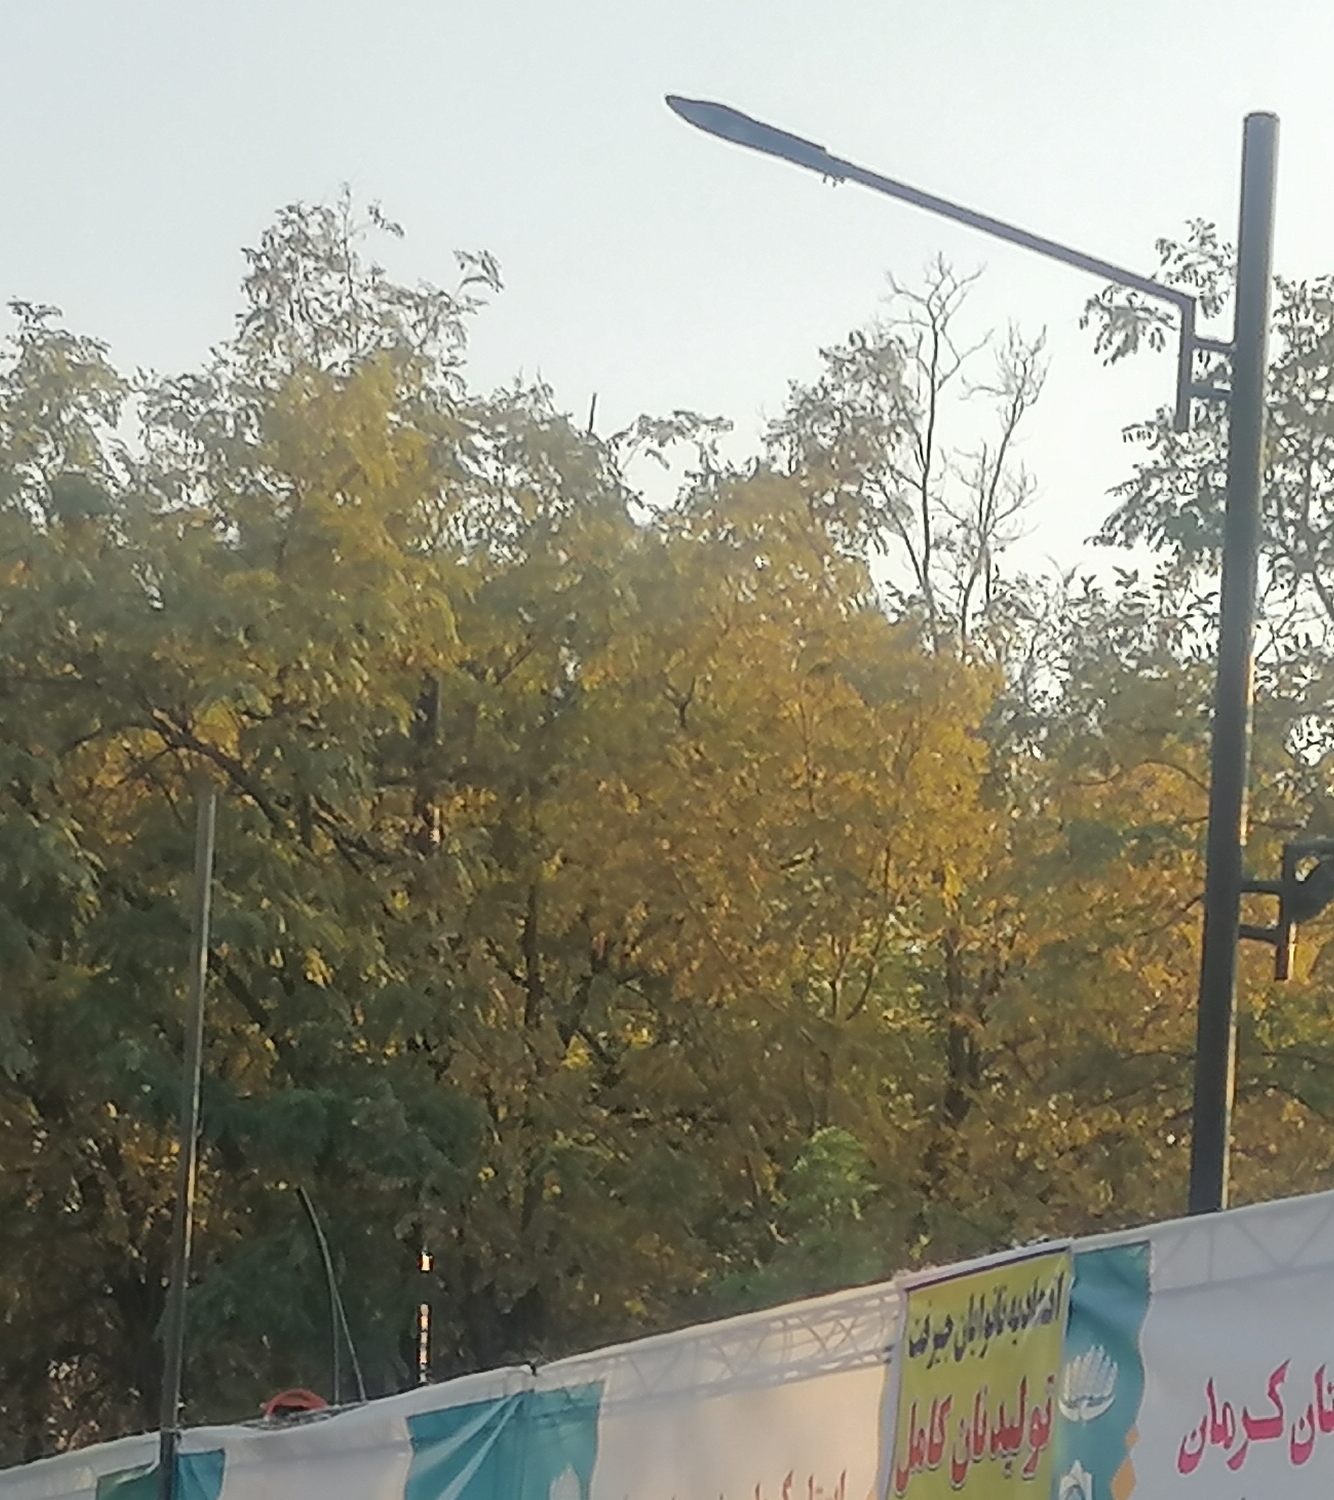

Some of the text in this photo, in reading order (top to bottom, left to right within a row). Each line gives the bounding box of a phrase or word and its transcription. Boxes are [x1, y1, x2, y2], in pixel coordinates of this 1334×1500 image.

[893, 1373, 1055, 1498] تولید نان کامل
[1177, 1357, 1292, 1475] کرمان
